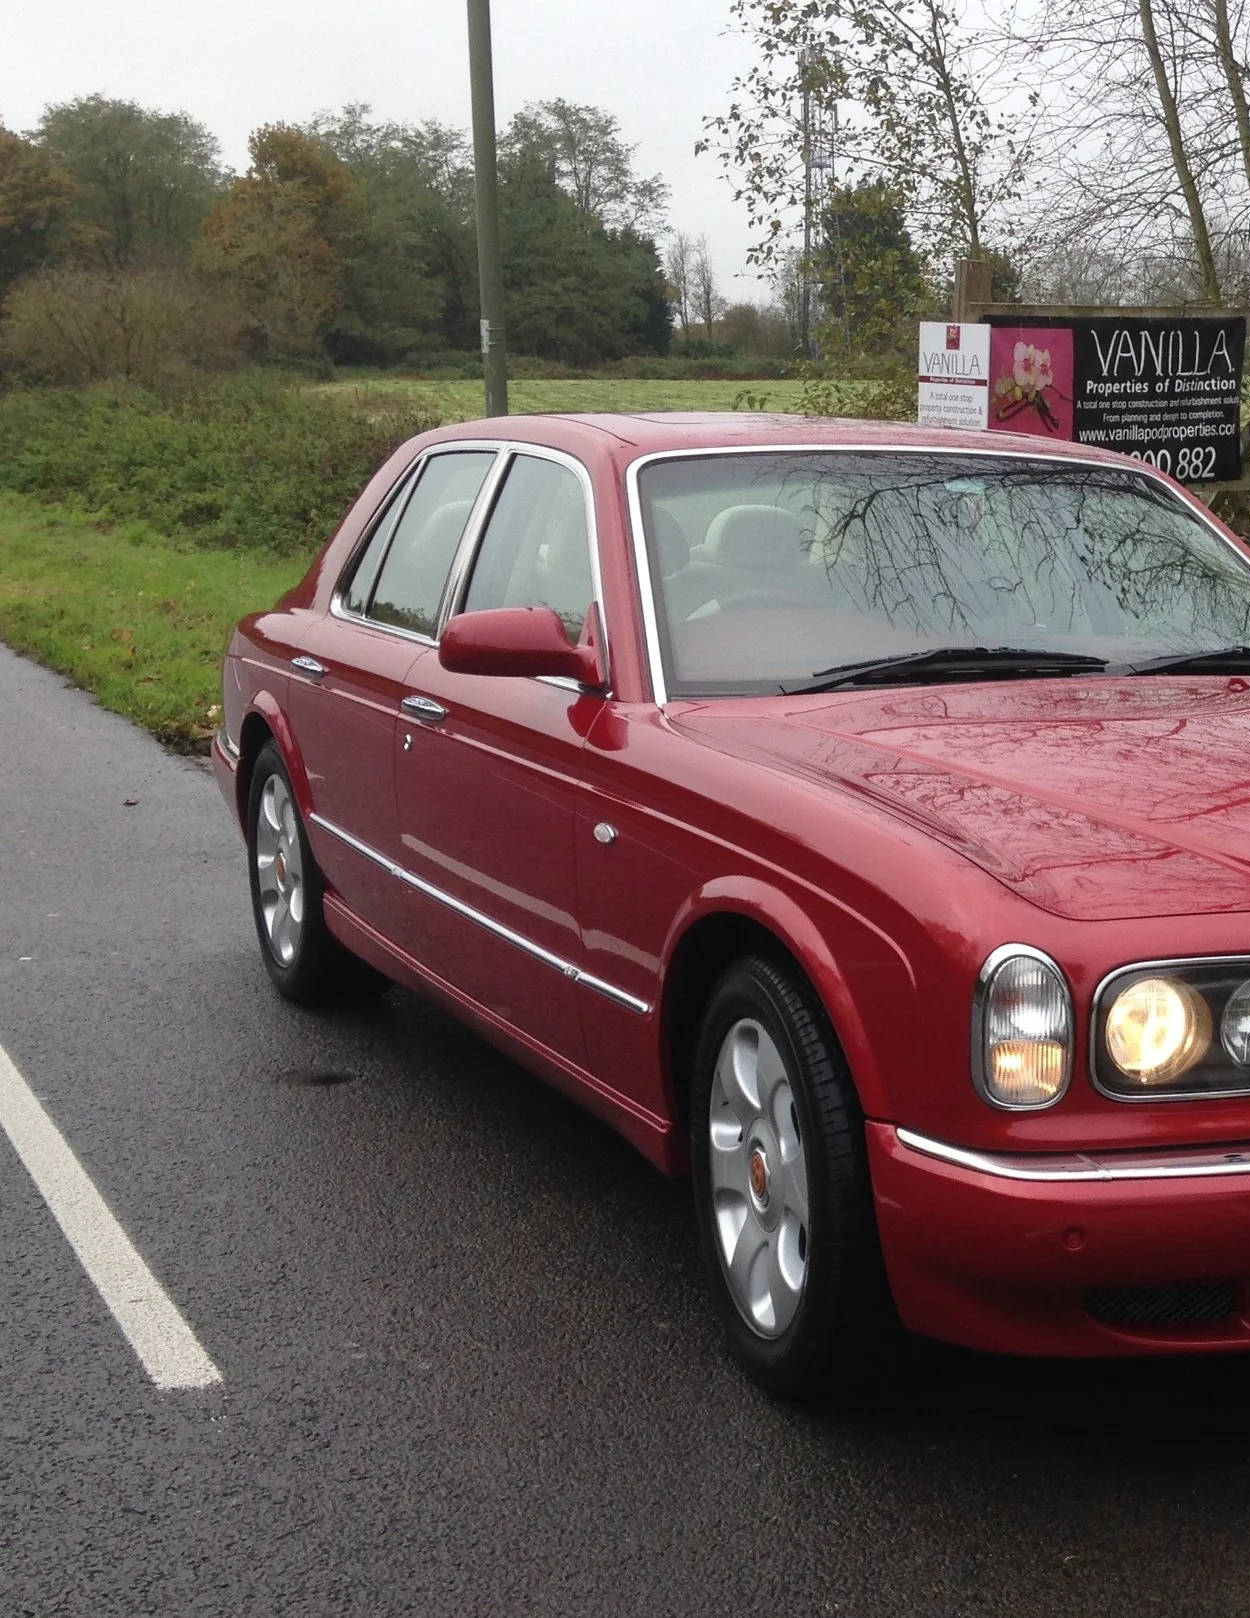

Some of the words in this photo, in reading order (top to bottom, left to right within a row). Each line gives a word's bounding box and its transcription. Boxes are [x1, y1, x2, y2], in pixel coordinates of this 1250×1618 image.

[1086, 379, 1149, 397] Properties
[1155, 378, 1170, 393] of
[1174, 376, 1236, 393] Distinction
[929, 391, 935, 400] A
[935, 392, 948, 400] total
[948, 394, 959, 402] one
[960, 394, 973, 403] stop
[920, 403, 941, 413] property
[943, 404, 977, 414] construction
[978, 406, 983, 416] &
[1076, 400, 1082, 409] A
[1083, 399, 1098, 409] total
[1099, 401, 1110, 409] one
[1112, 400, 1127, 410] stop
[1128, 399, 1168, 408] construction
[1103, 413, 1120, 422] From
[1121, 413, 1148, 424] planning
[1149, 412, 1161, 421] and
[1162, 411, 1179, 422] design
[1180, 411, 1187, 420] to
[1176, 446, 1216, 480] 882
